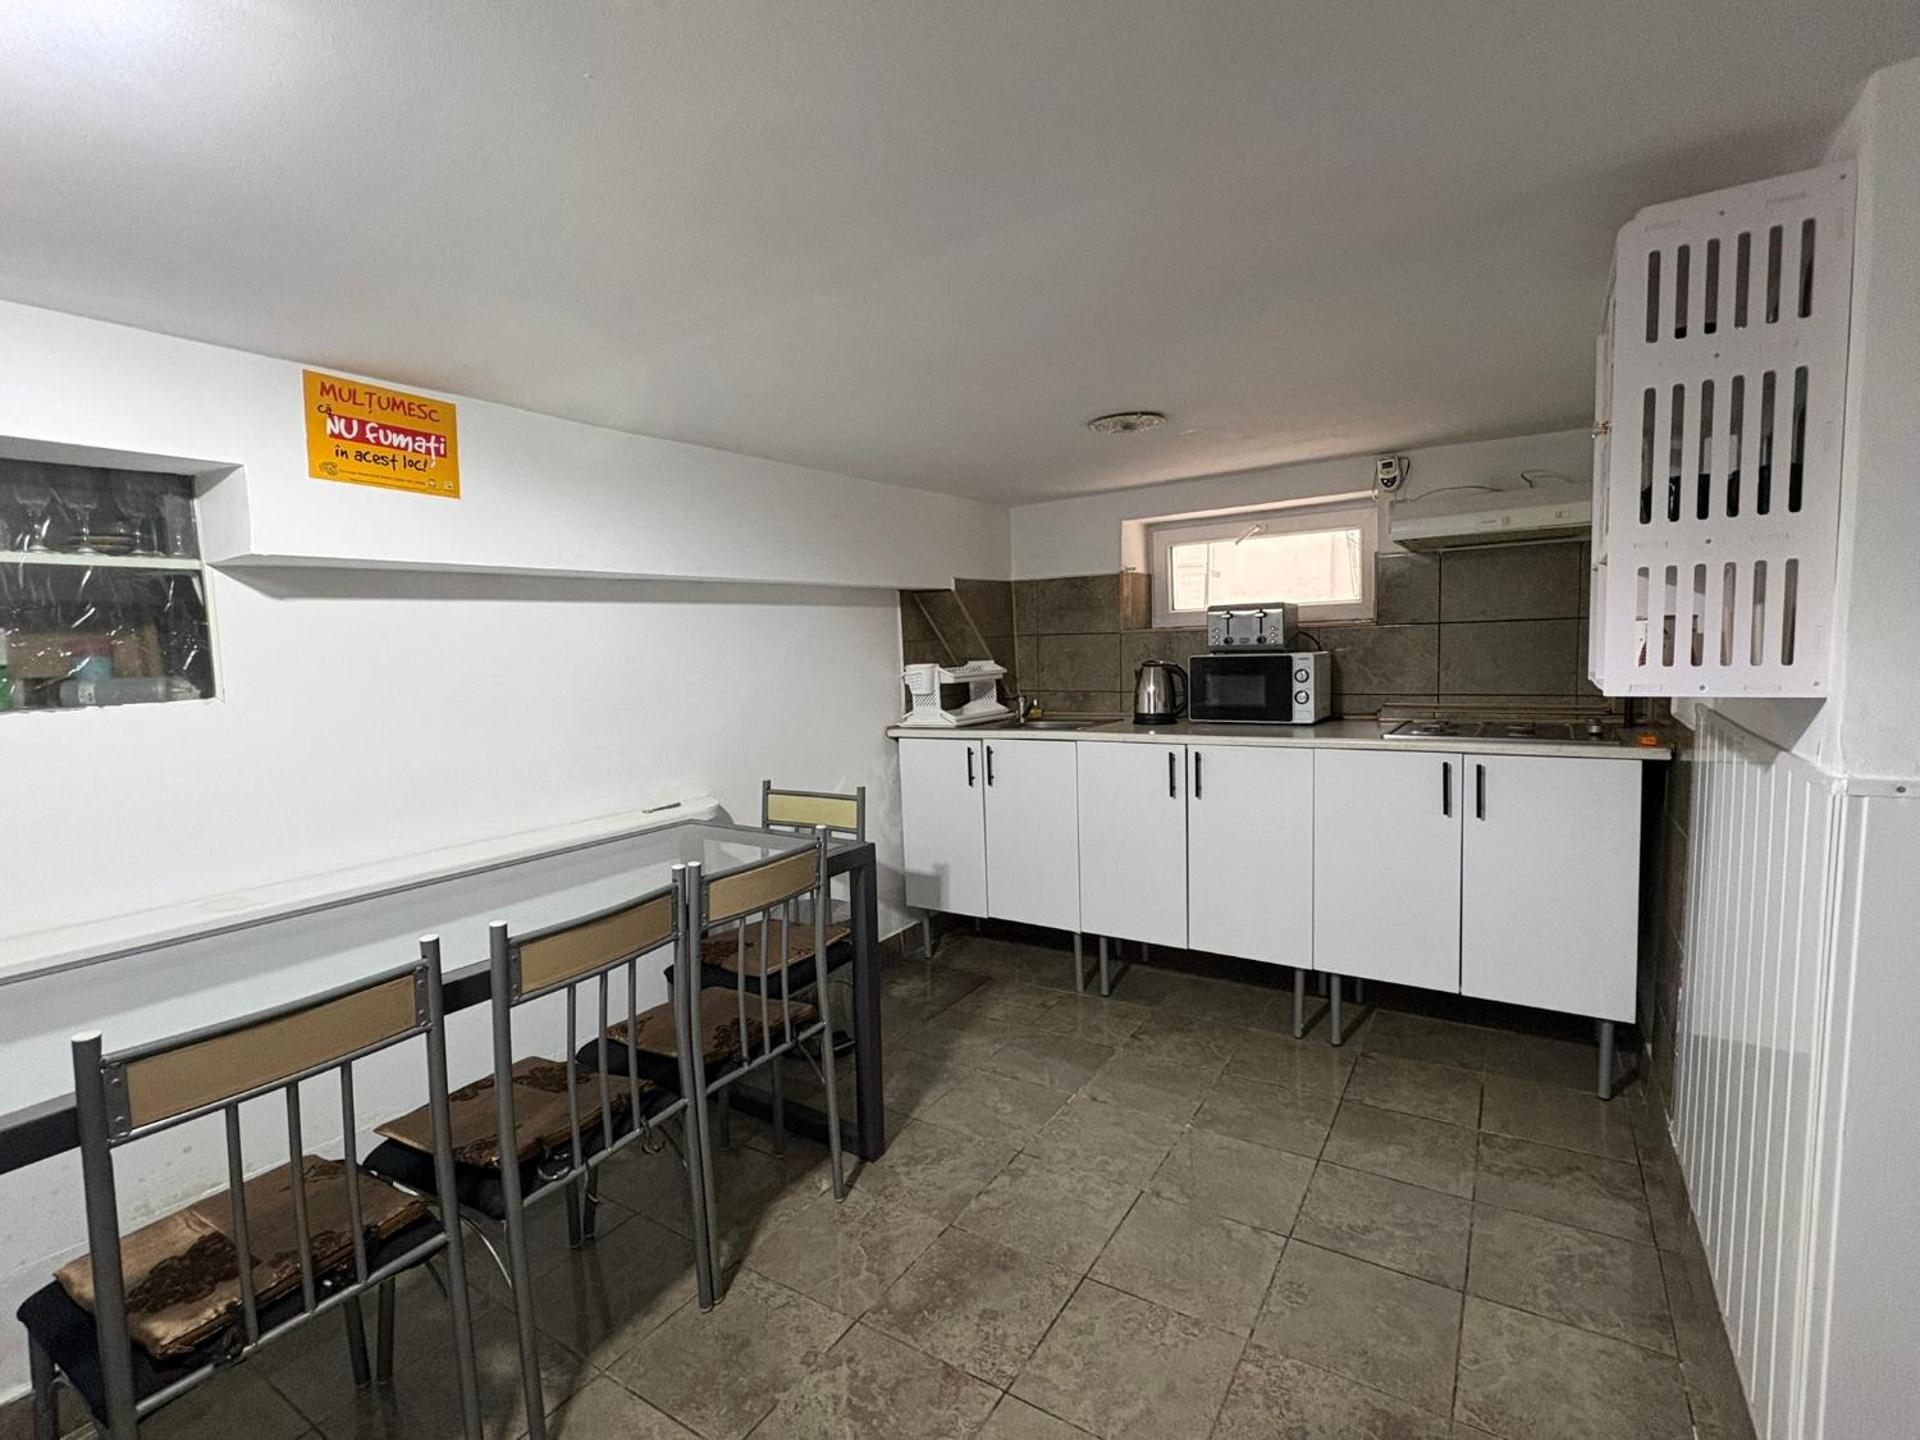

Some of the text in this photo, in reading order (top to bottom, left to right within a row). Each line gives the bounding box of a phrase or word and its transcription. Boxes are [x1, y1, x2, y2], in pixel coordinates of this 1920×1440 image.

[326, 415, 359, 439] NU
[335, 444, 428, 472] în acest loc!
